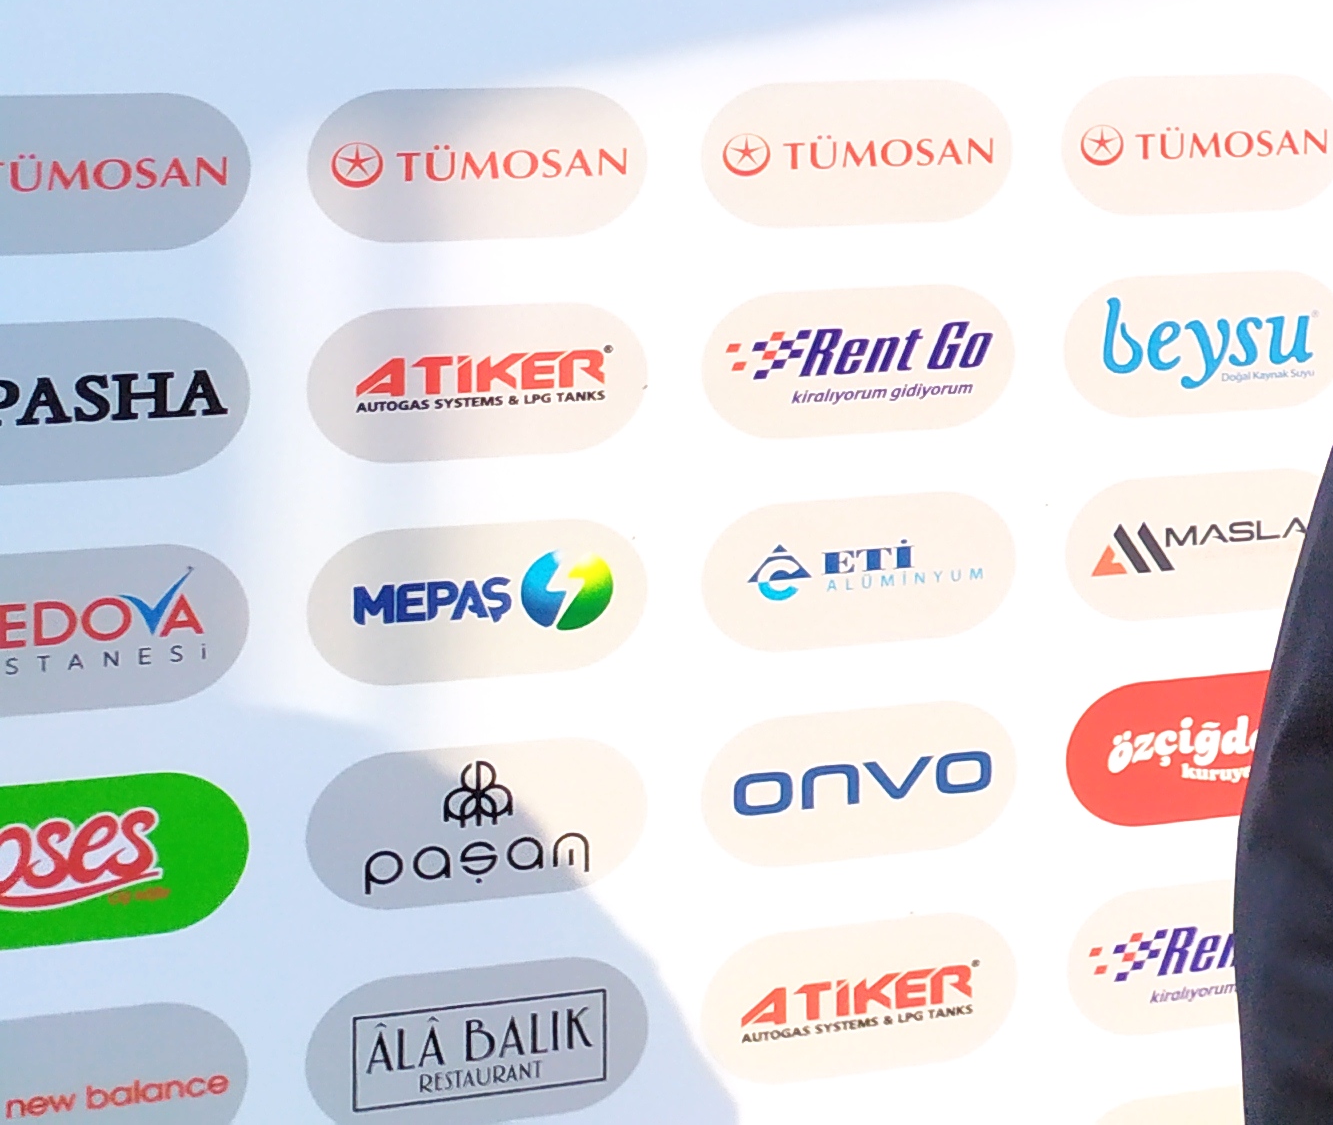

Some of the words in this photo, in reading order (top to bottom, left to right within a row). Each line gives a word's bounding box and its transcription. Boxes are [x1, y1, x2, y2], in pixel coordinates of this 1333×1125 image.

[395, 143, 628, 183] TÜMOSAN
[783, 134, 994, 171] TÜMOSAN
[1135, 126, 1328, 160] TÜMOSAN
[0, 153, 228, 193] ÜMOSAN
[798, 327, 923, 377] Rent
[928, 320, 993, 370] Go
[1103, 296, 1314, 389] beysu
[356, 399, 430, 414] AUTOGAS
[434, 395, 502, 409] SYSTEMS
[508, 395, 519, 405] &
[524, 392, 551, 405] LPG
[557, 389, 606, 403] TANKS
[890, 379, 974, 402] gidiyorum
[821, 538, 915, 575] ETİ
[352, 574, 512, 626] MEPAŞ
[827, 568, 985, 592] ALÜMİNYUM
[364, 832, 590, 895] paşam
[365, 1015, 444, 1075] ÂLÂ
[465, 1005, 594, 1060] BALIK
[741, 1025, 811, 1044] AUTOGAS
[814, 1016, 879, 1035] SYSTEMS
[882, 1014, 893, 1026] &
[897, 1010, 923, 1024] LPG
[928, 1003, 974, 1019] TANKS
[5, 1091, 77, 1120] new
[85, 1074, 230, 1111] balance
[418, 1060, 542, 1095] RESTAURANT
